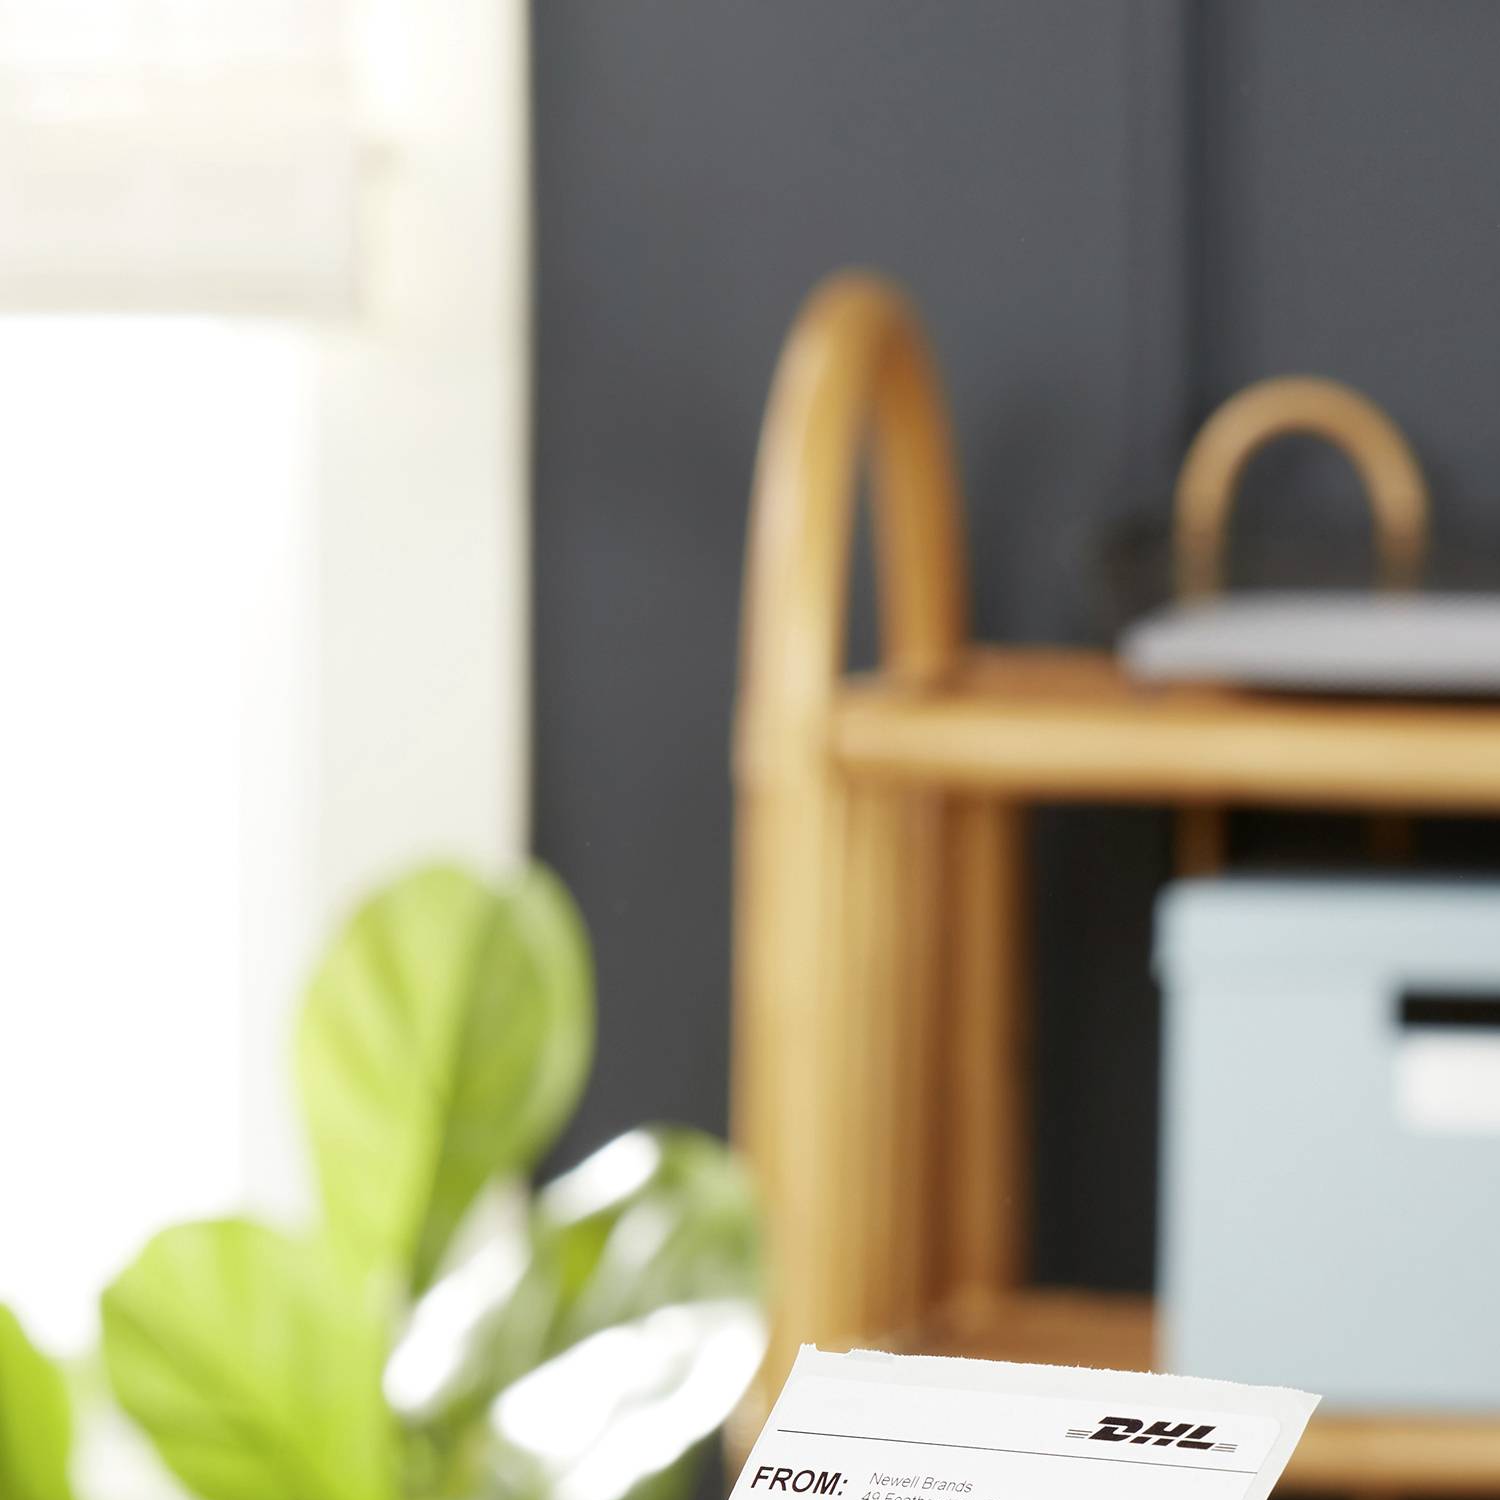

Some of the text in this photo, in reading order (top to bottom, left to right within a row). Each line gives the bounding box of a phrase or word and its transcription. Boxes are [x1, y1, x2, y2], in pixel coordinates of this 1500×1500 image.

[1088, 1416, 1216, 1450] DHL
[750, 1465, 848, 1496] FROM:
[869, 1472, 974, 1493] Newell Brands
